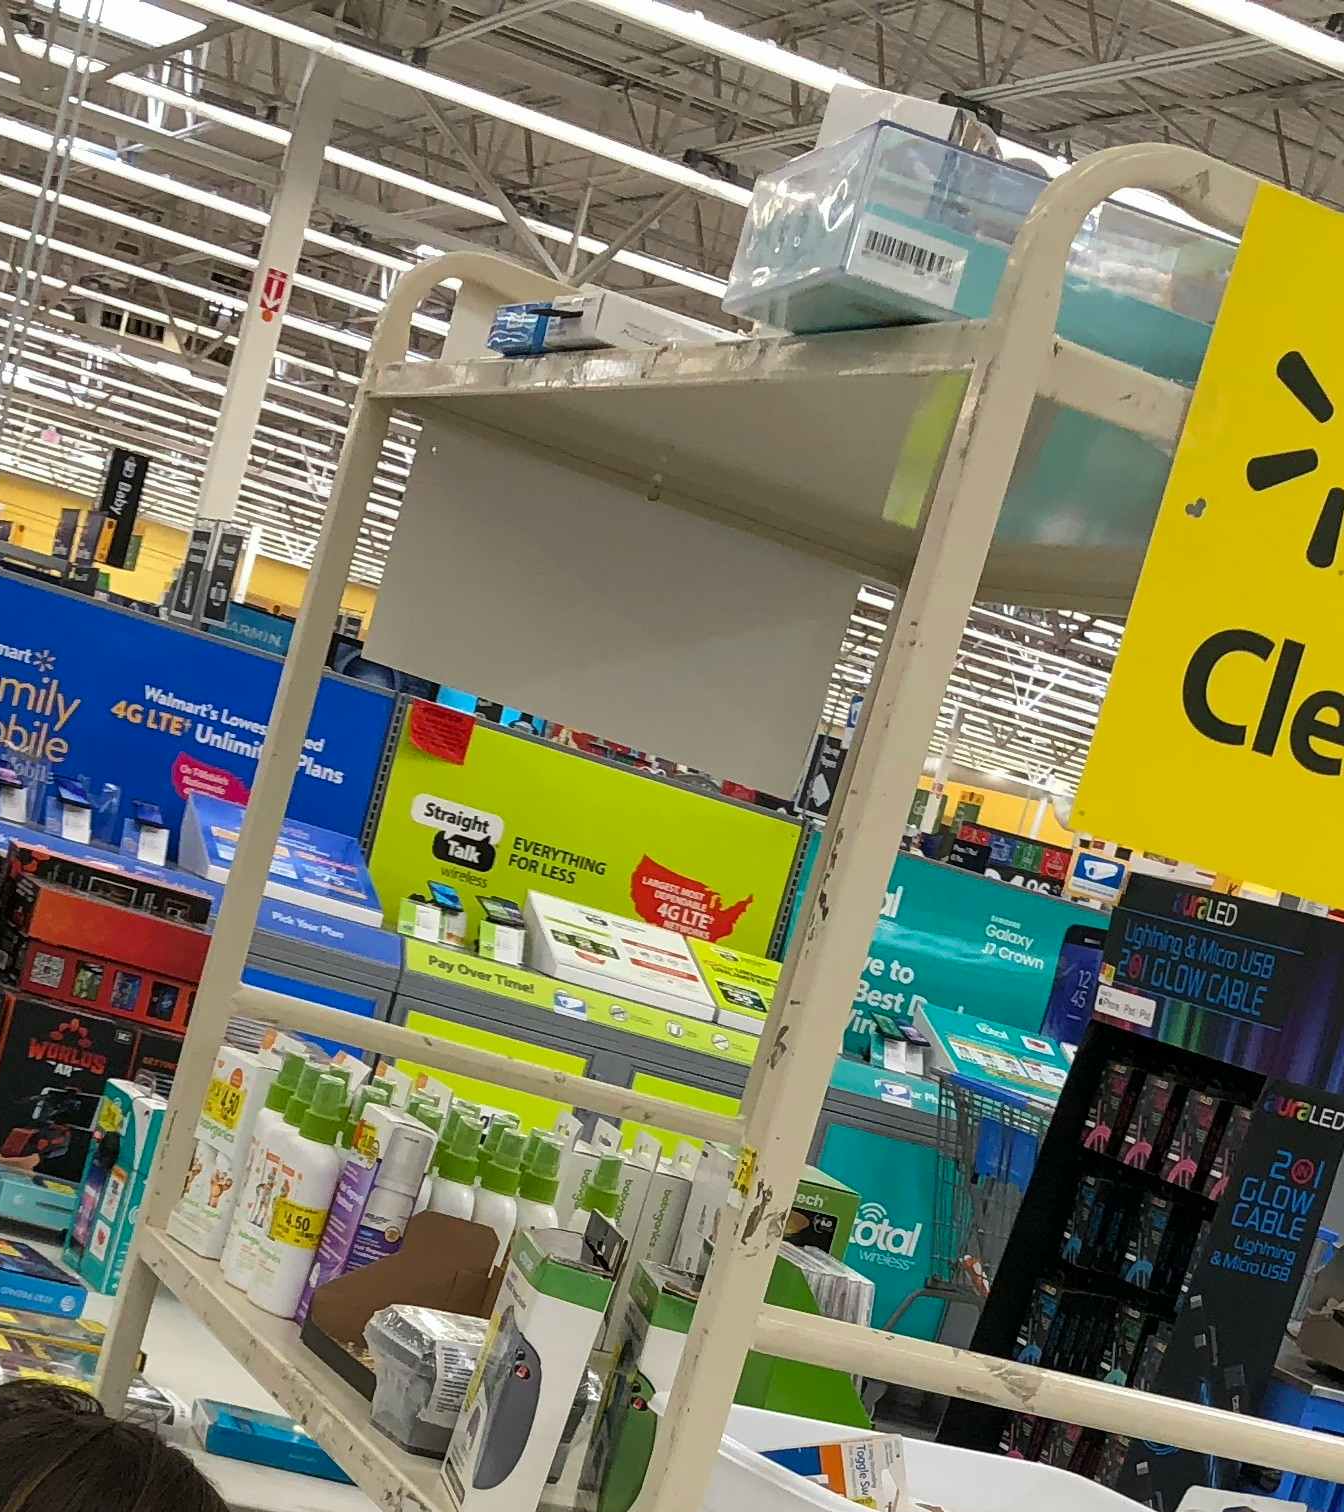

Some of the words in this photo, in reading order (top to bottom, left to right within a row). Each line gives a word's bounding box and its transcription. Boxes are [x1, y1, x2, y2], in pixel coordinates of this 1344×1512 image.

[223, 619, 283, 647] ARMIN
[144, 684, 219, 721] Walmart's
[221, 708, 267, 737] Lowes
[110, 700, 144, 724] 4G
[195, 723, 265, 759] Unlimit
[297, 753, 344, 785] Plans
[424, 801, 490, 834] Straight
[447, 839, 480, 864] Talk
[513, 836, 607, 876] EVERYTHING
[441, 866, 488, 889] wireless
[508, 853, 537, 873] FOR
[541, 863, 577, 885] LESS
[657, 902, 680, 921] 4G
[1172, 892, 1239, 927] auraLED
[985, 923, 1035, 950] Galaxy
[1124, 918, 1183, 961] Lightning
[1199, 939, 1240, 969] Micro
[1241, 952, 1277, 980] USB
[428, 954, 454, 975] Pay
[457, 963, 492, 981] Over
[495, 974, 536, 994] Time!
[890, 961, 915, 984] to
[998, 946, 1045, 970] Crown
[1078, 970, 1093, 990] 12
[1151, 958, 1206, 999] GLOW
[1208, 973, 1271, 1017] CABLE
[855, 980, 905, 1014] Best
[1070, 990, 1087, 1009] 45
[28, 1037, 108, 1077] WORLDS
[53, 1062, 75, 1078] AR
[796, 1191, 824, 1209] ech
[1239, 1176, 1316, 1216] GLOW
[1231, 1202, 1306, 1242] CABLE
[859, 1249, 915, 1271] wireless
[1234, 1234, 1297, 1266] Lightning
[1222, 1252, 1258, 1274] Micro
[1260, 1262, 1292, 1282] USB
